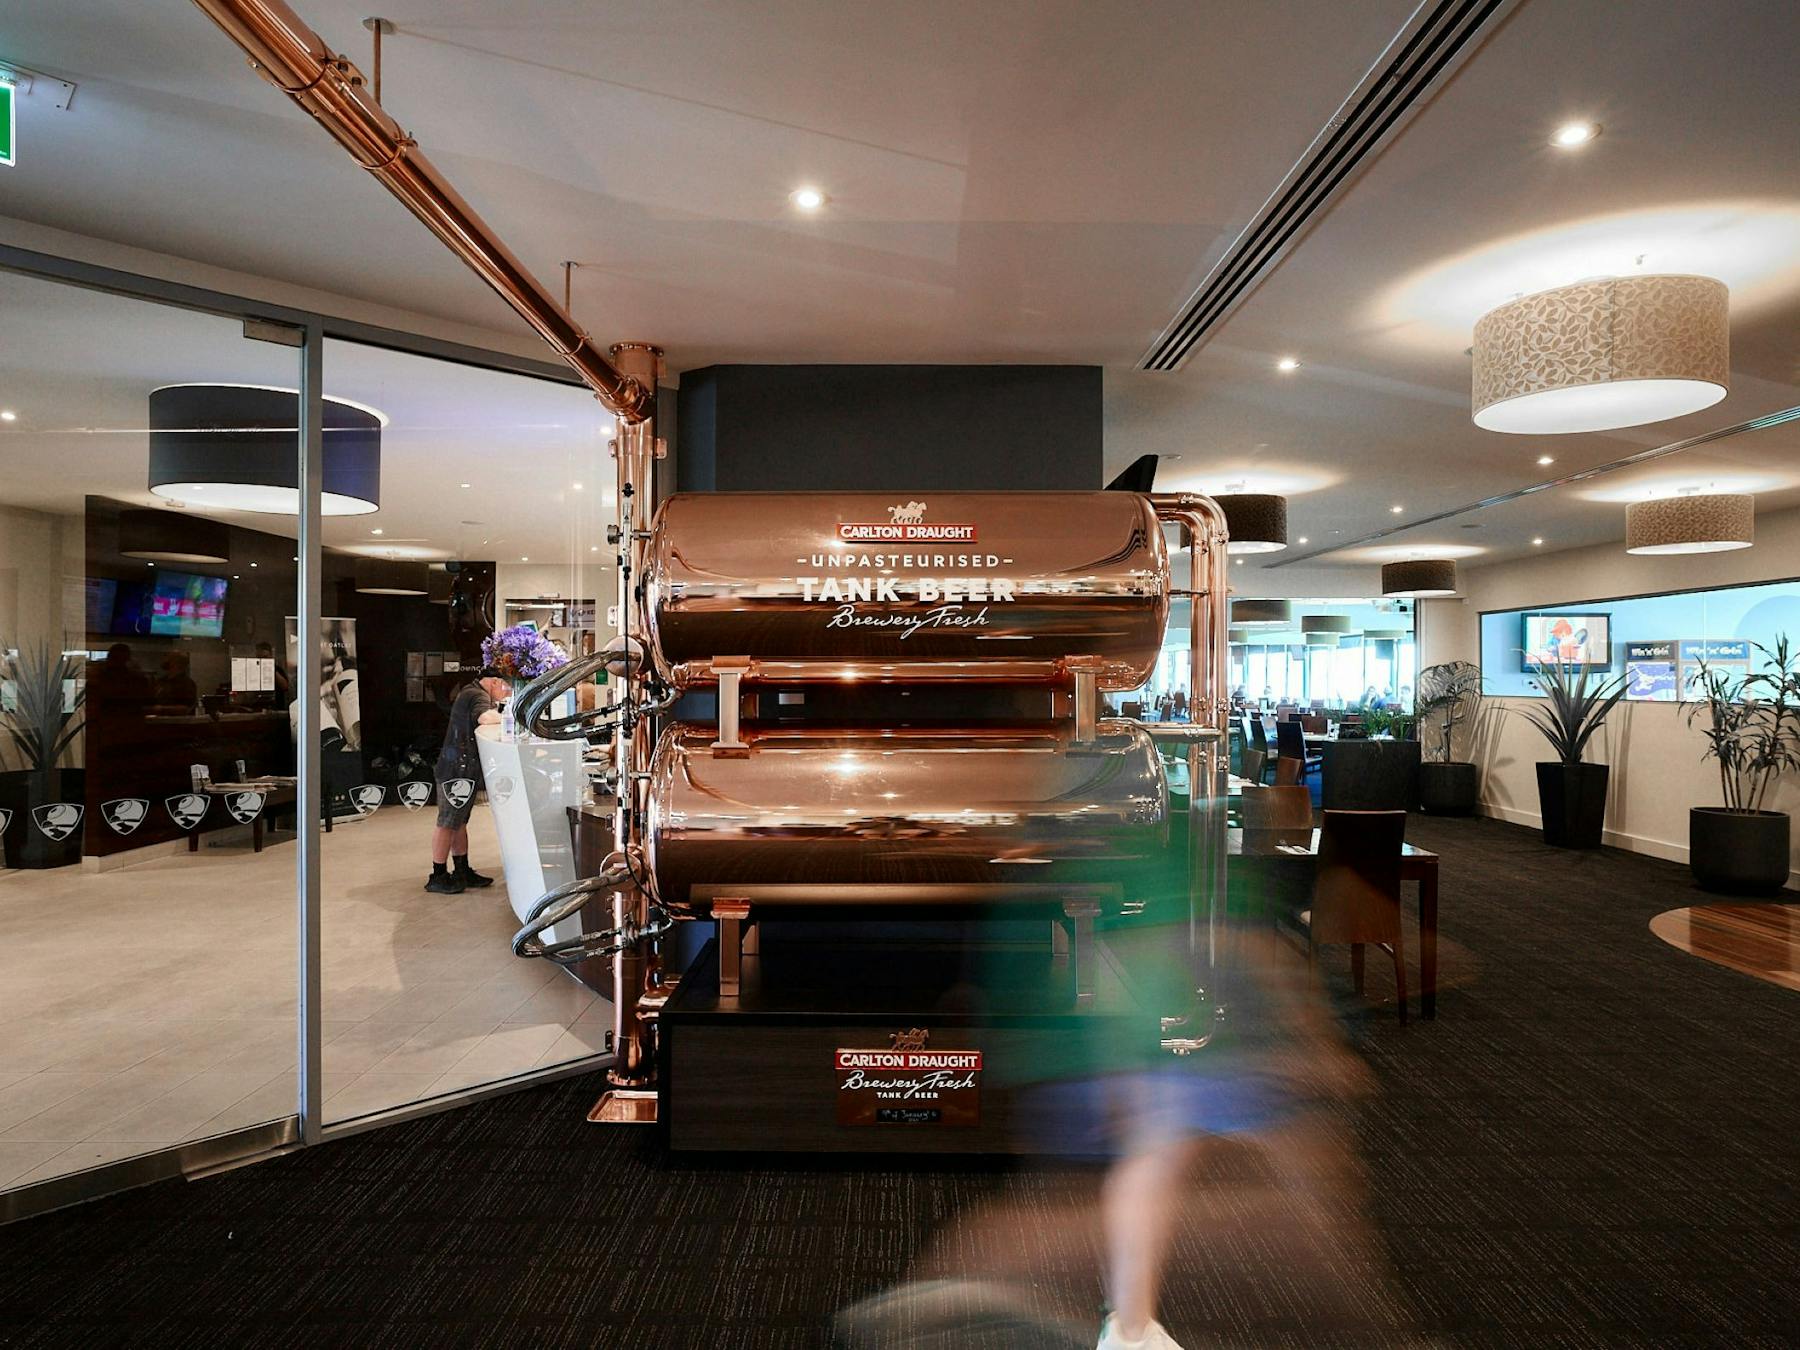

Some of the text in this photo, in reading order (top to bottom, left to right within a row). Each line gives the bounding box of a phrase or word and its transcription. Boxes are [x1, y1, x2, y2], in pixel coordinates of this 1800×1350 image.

[840, 525, 974, 539] CARLTON DRAUGHT
[797, 577, 1015, 602] TANK BEER
[827, 604, 990, 640] Brewery Fresh
[839, 1054, 978, 1068] CARLTON DRAUGHT
[841, 1069, 976, 1100] Brewery Fresh
